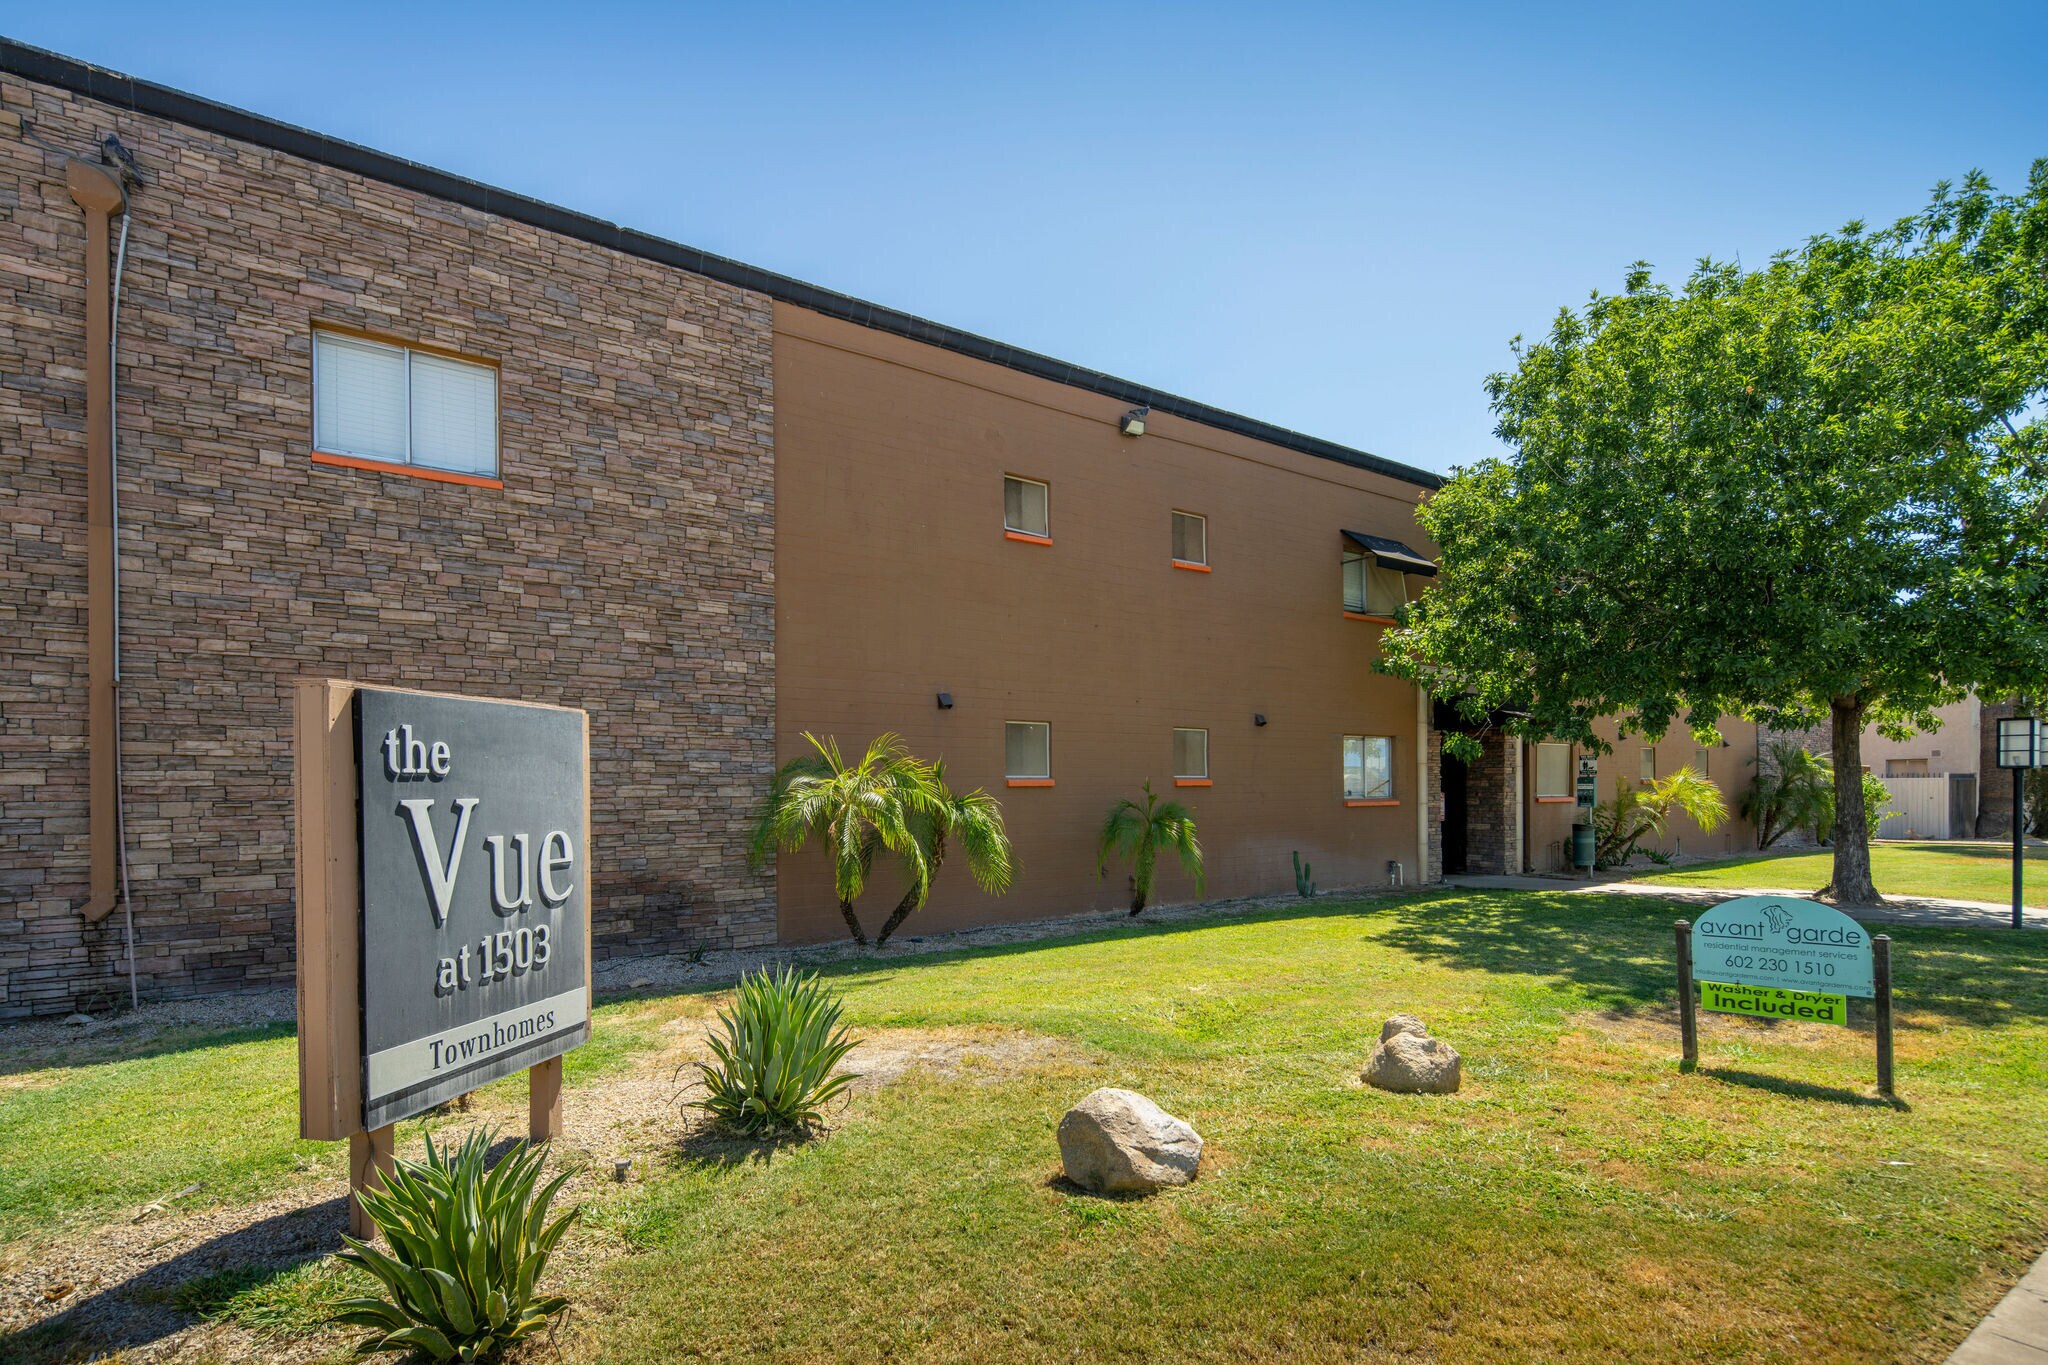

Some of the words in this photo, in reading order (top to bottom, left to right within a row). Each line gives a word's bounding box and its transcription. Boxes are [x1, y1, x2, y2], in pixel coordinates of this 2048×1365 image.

[385, 724, 450, 777] the
[399, 798, 574, 921] Vue
[1700, 921, 1765, 937] avant
[1786, 926, 1861, 945] garde
[438, 944, 471, 988] at
[481, 924, 551, 978] 1503
[1703, 941, 1749, 951] residential
[1751, 945, 1816, 956] management
[1819, 951, 1858, 960] services
[1725, 955, 1753, 968] 602
[1759, 957, 1788, 972] 230
[1795, 960, 1834, 976] 1510
[1708, 983, 1769, 997] Washer
[1775, 990, 1786, 999] &
[1793, 992, 1842, 1005] Dryer
[1714, 993, 1834, 1020] Included
[429, 1010, 555, 1070] Townhomes
